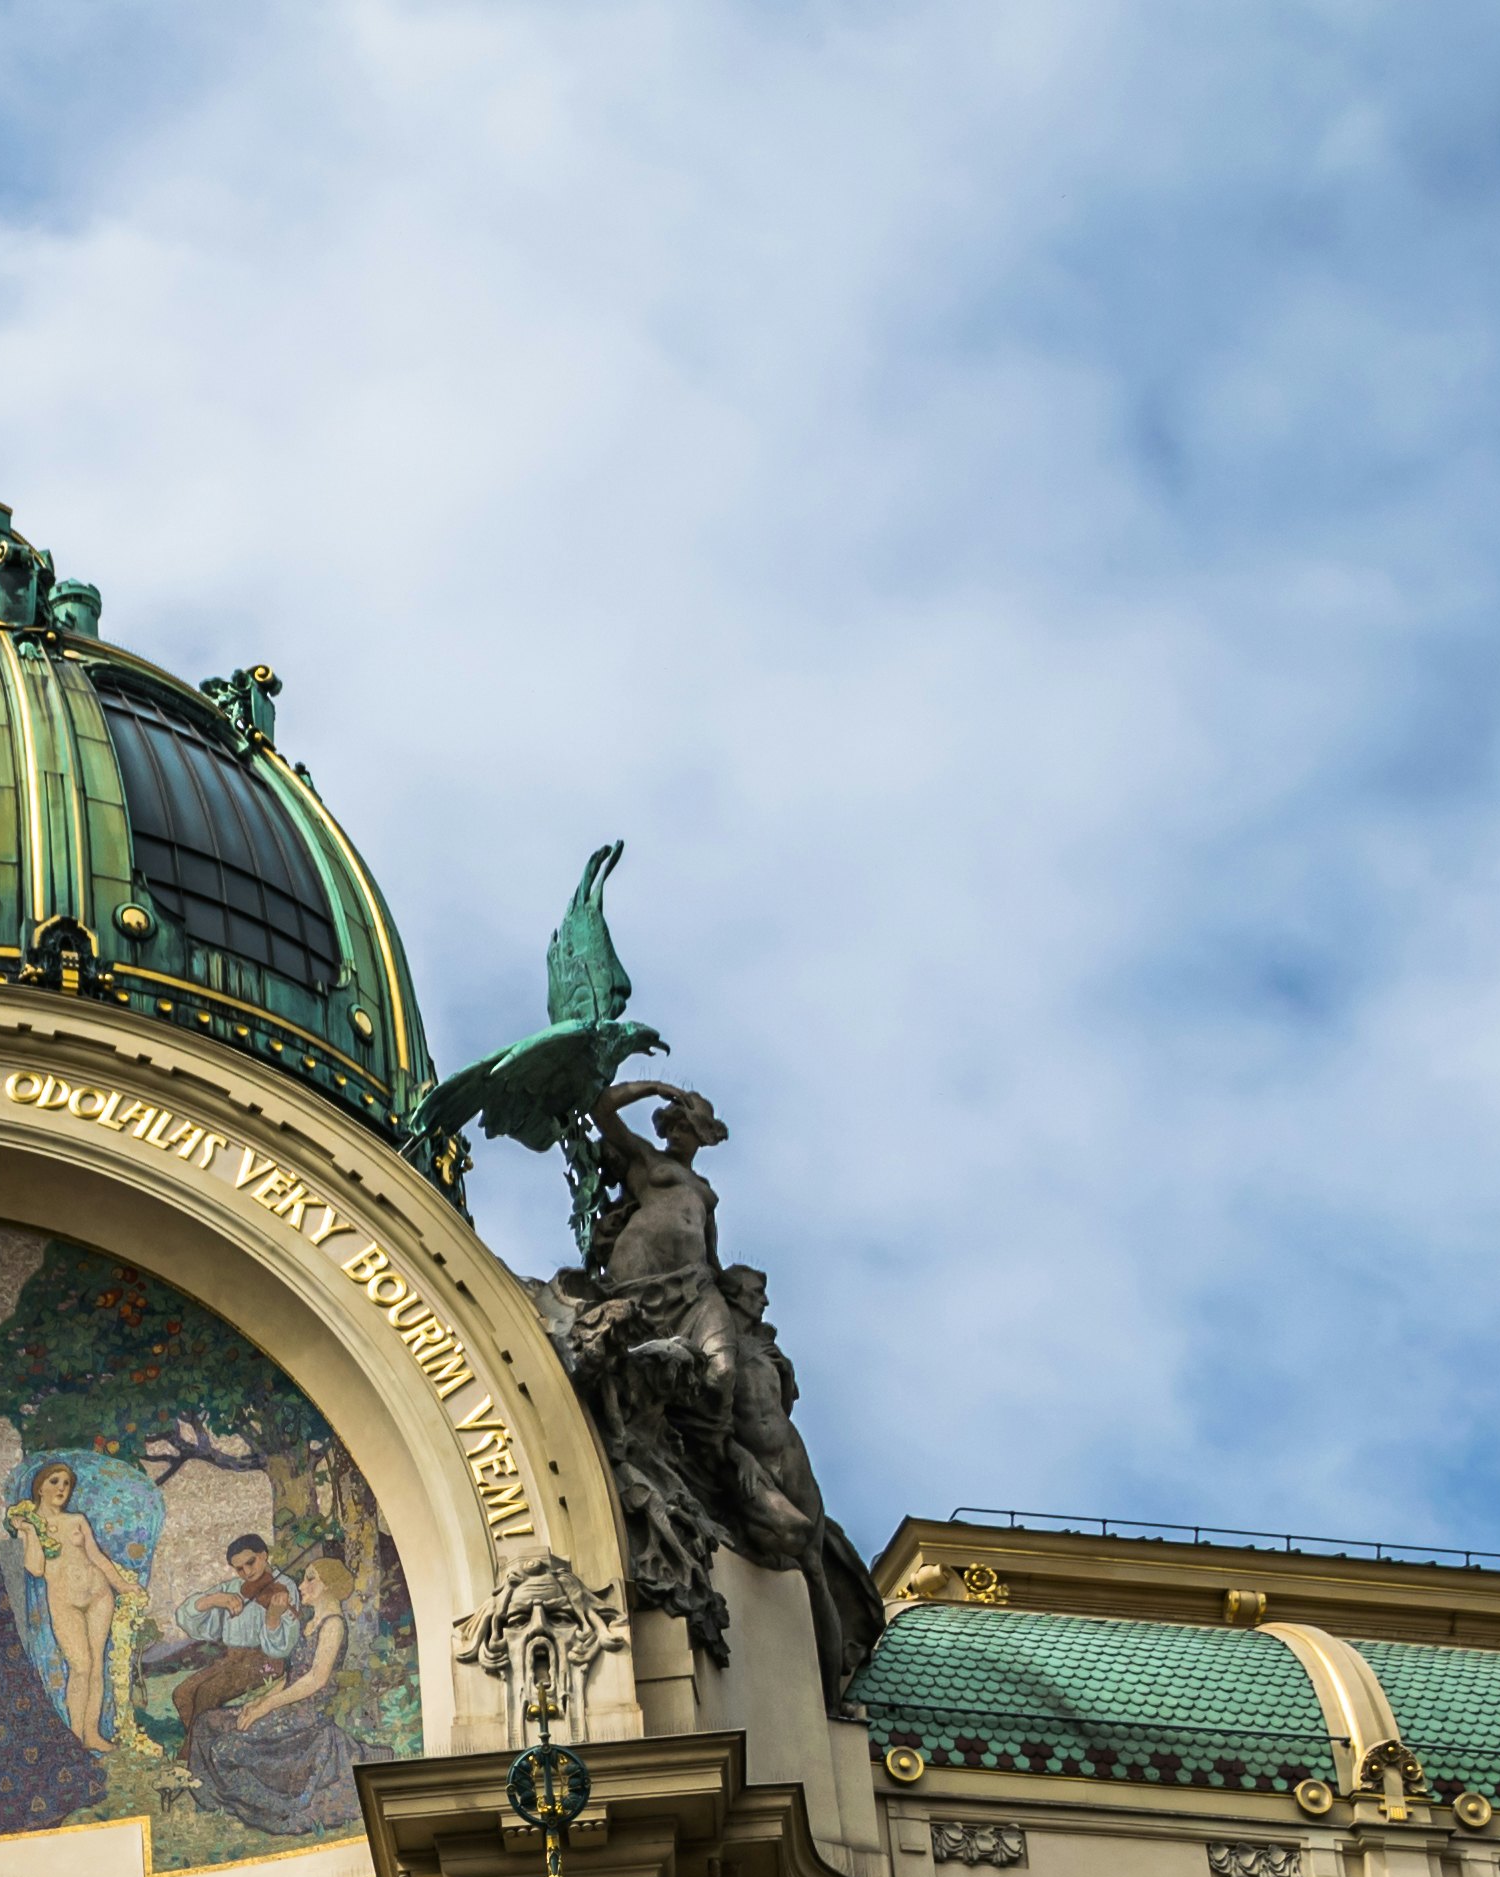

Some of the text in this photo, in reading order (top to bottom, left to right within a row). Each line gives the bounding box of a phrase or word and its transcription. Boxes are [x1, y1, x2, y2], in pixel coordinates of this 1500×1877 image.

[4, 1070, 227, 1169] ODOLALAS
[233, 1146, 356, 1245] VĚKY
[340, 1240, 476, 1400] BOUŘÍM
[455, 1394, 535, 1540] VŠEM!
